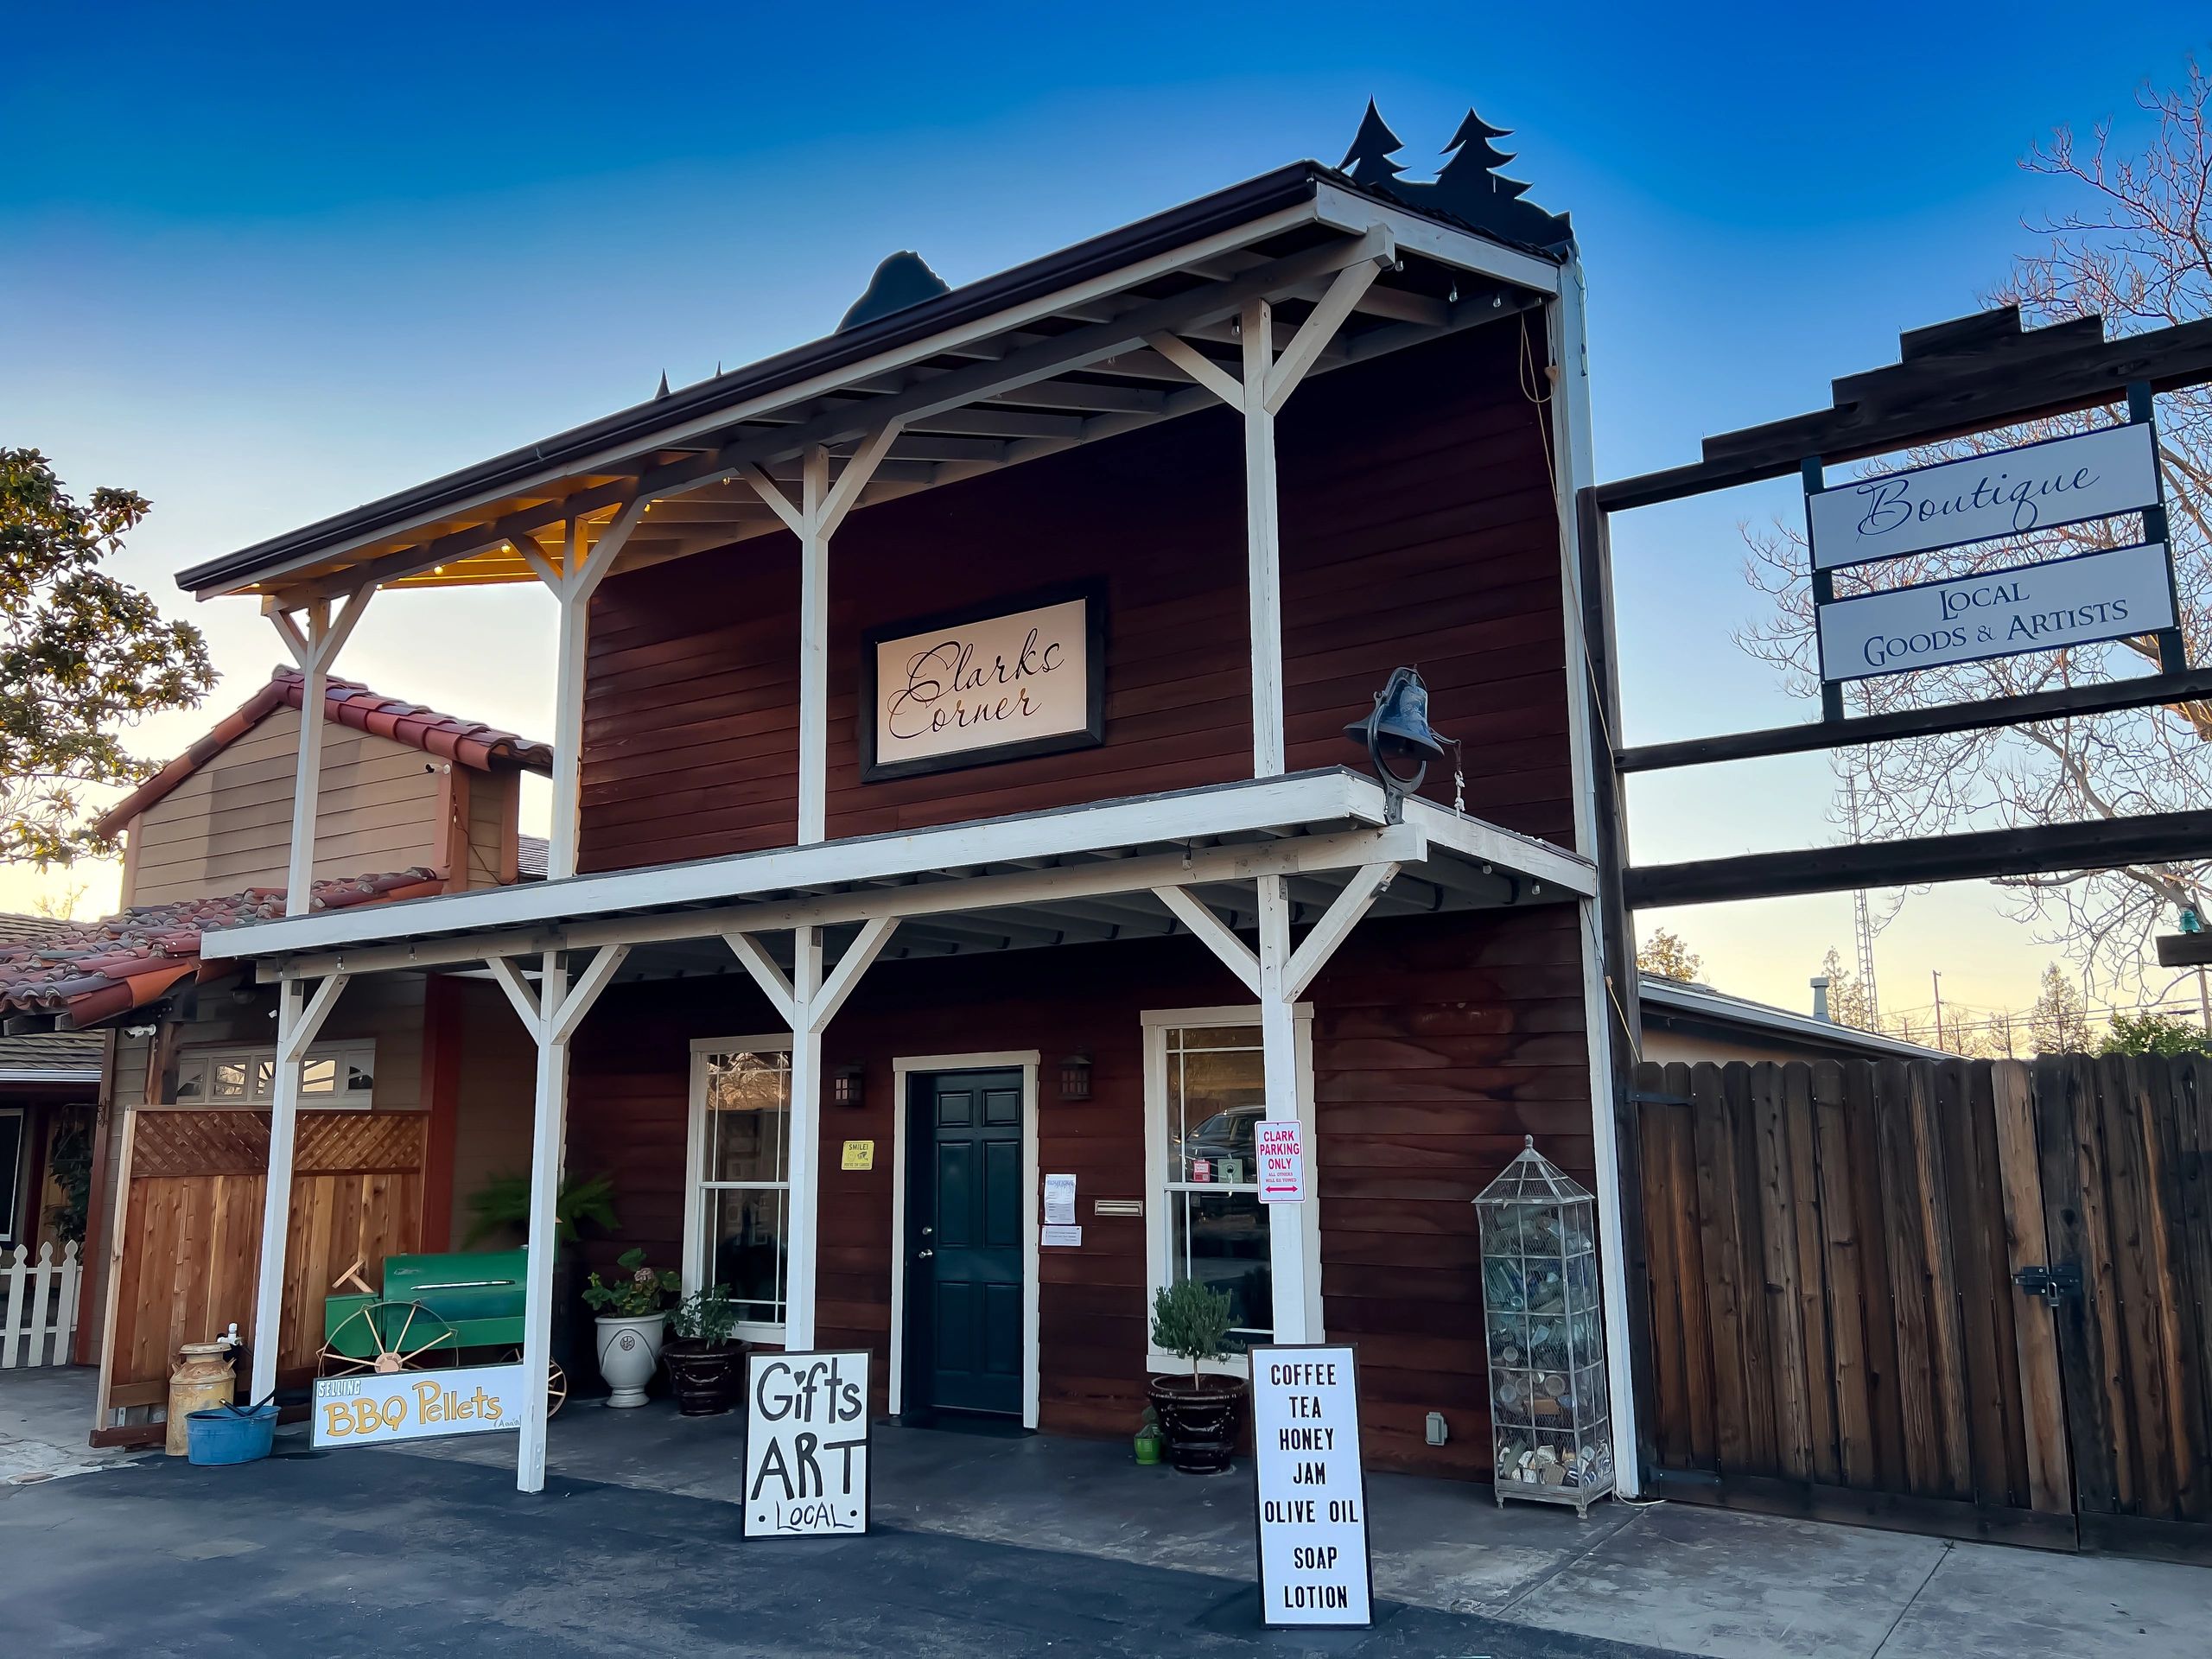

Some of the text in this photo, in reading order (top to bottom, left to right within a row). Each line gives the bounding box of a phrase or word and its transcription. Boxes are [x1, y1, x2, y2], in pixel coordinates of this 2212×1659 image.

[1856, 467, 2101, 543] Boutique
[1977, 625, 1997, 643] &
[906, 627, 1065, 702] Clarks
[887, 680, 1043, 740] Corner
[1263, 1130, 1294, 1141] CLARK
[1260, 1143, 1300, 1156] PARKING
[1268, 1158, 1292, 1170] ONLY
[1270, 1363, 1337, 1386] COFFEE
[317, 1380, 362, 1398] SELLING
[756, 1357, 862, 1424] Gifts
[323, 1380, 503, 1437] BBQ Pellets
[1288, 1395, 1322, 1419] TEA
[1279, 1427, 1334, 1451] HONEY
[750, 1432, 867, 1501] ART
[1293, 1462, 1326, 1485] JAM
[776, 1500, 855, 1532] LOCAL
[1264, 1500, 1358, 1523] OLIVE OIL
[1294, 1546, 1338, 1569] SOAP
[1284, 1585, 1348, 1609] LOTION
